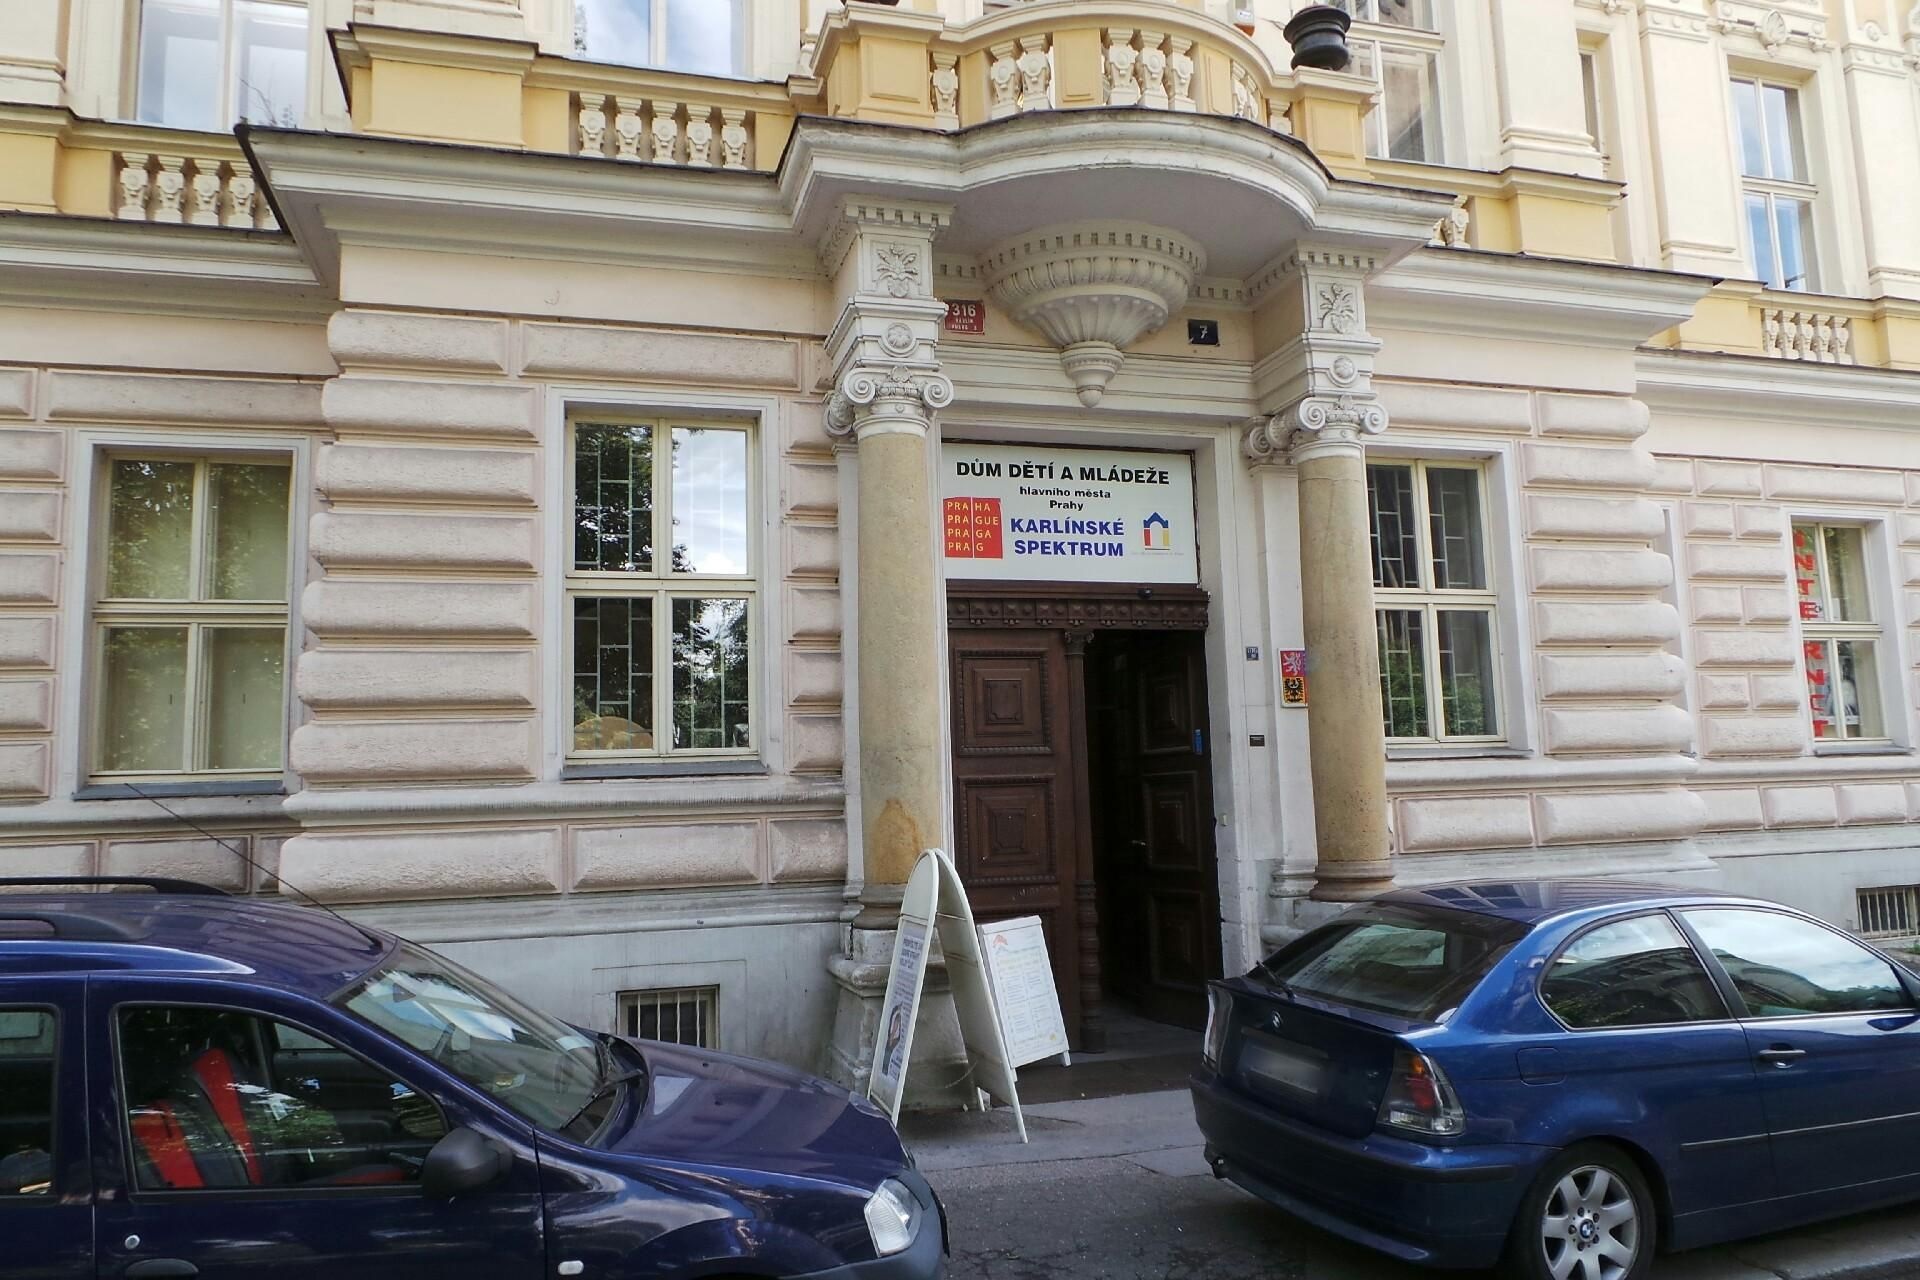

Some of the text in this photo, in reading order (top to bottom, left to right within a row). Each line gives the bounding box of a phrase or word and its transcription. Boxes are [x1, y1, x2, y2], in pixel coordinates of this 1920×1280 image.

[952, 303, 976, 317] 316
[1200, 325, 1208, 339] 7
[956, 458, 1170, 485] DŮM DĚTÍ A MLÁDEŽE
[1074, 489, 1111, 499] města
[1049, 500, 1084, 511] Prahy
[1010, 517, 1125, 536] KARLÍNSKÉ
[1014, 539, 1124, 557] SPEKTRUM
